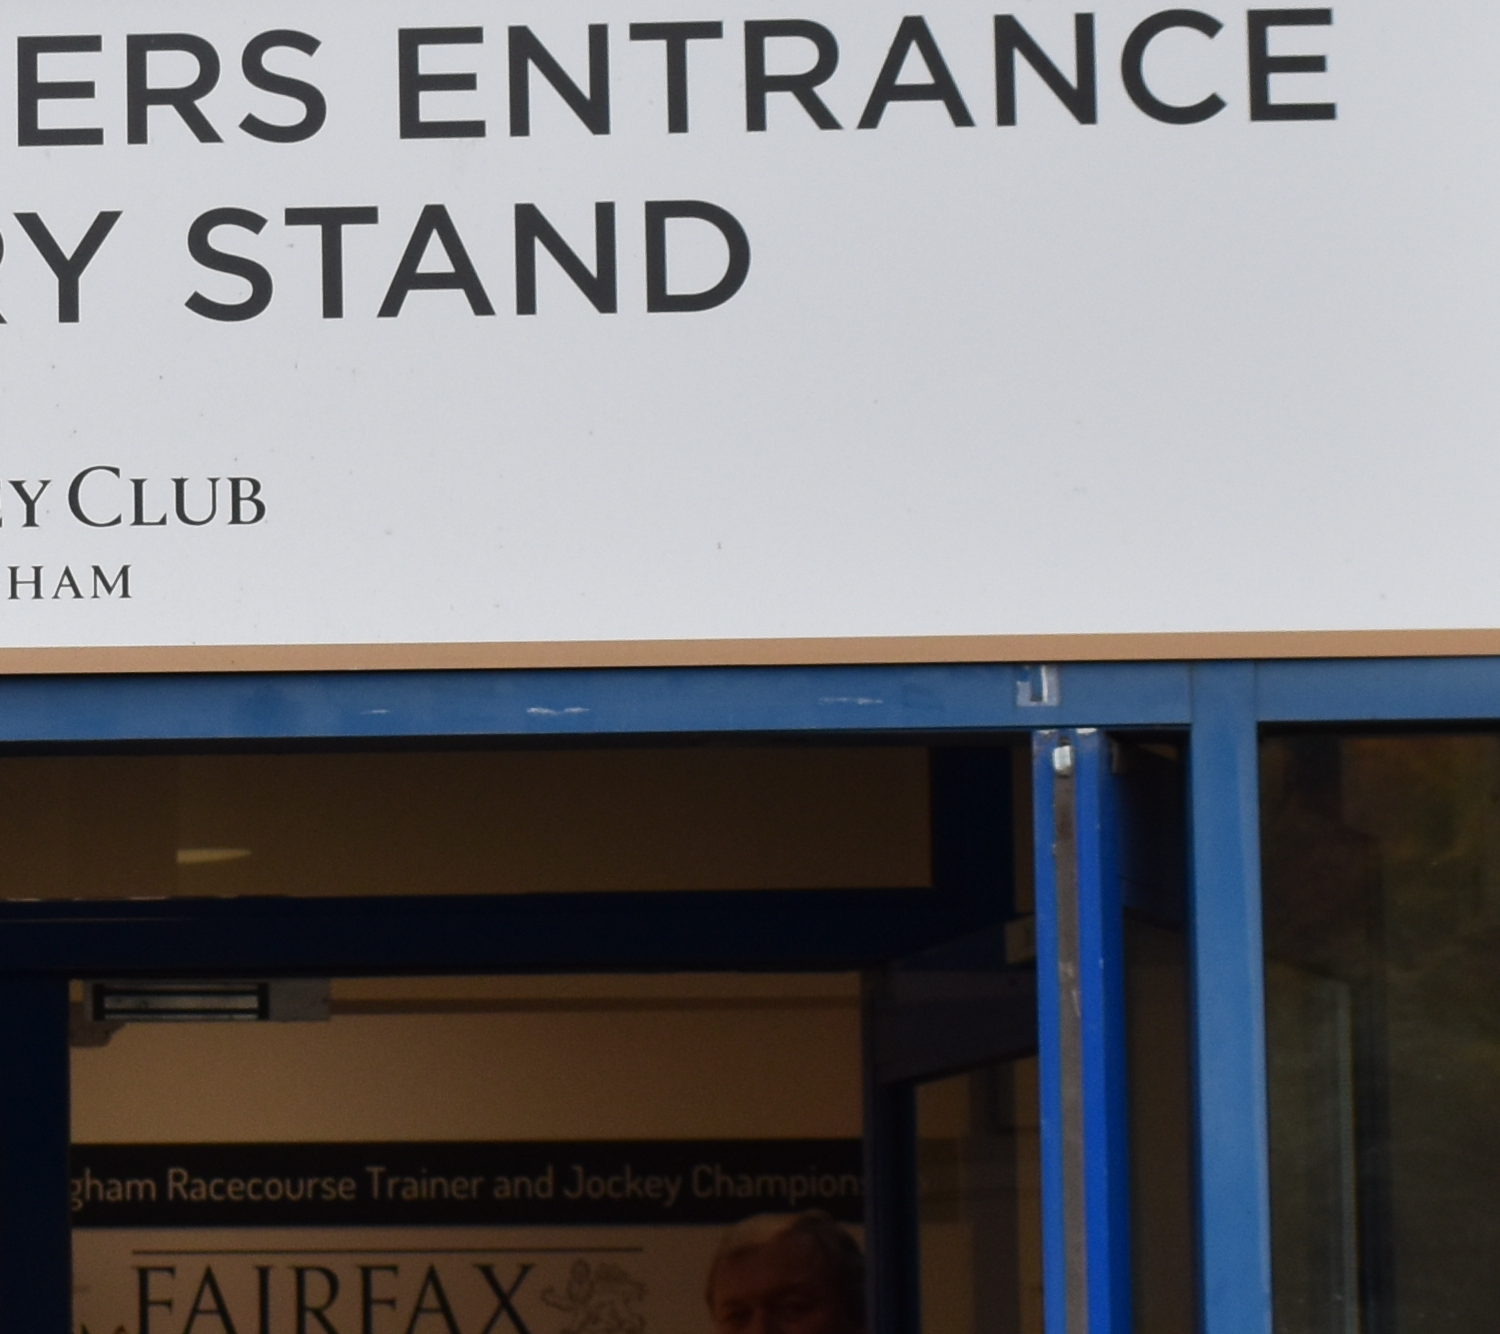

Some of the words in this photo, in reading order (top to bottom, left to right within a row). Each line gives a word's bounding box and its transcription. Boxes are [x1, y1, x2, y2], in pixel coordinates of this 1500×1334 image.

[398, 8, 1336, 139] ENTRANCE
[185, 200, 750, 322] STAND
[68, 466, 265, 527] CLUB
[168, 1167, 356, 1201] Racecourse
[366, 1166, 483, 1200] Trainer
[493, 1165, 553, 1199] and
[563, 1164, 682, 1207] Jockey
